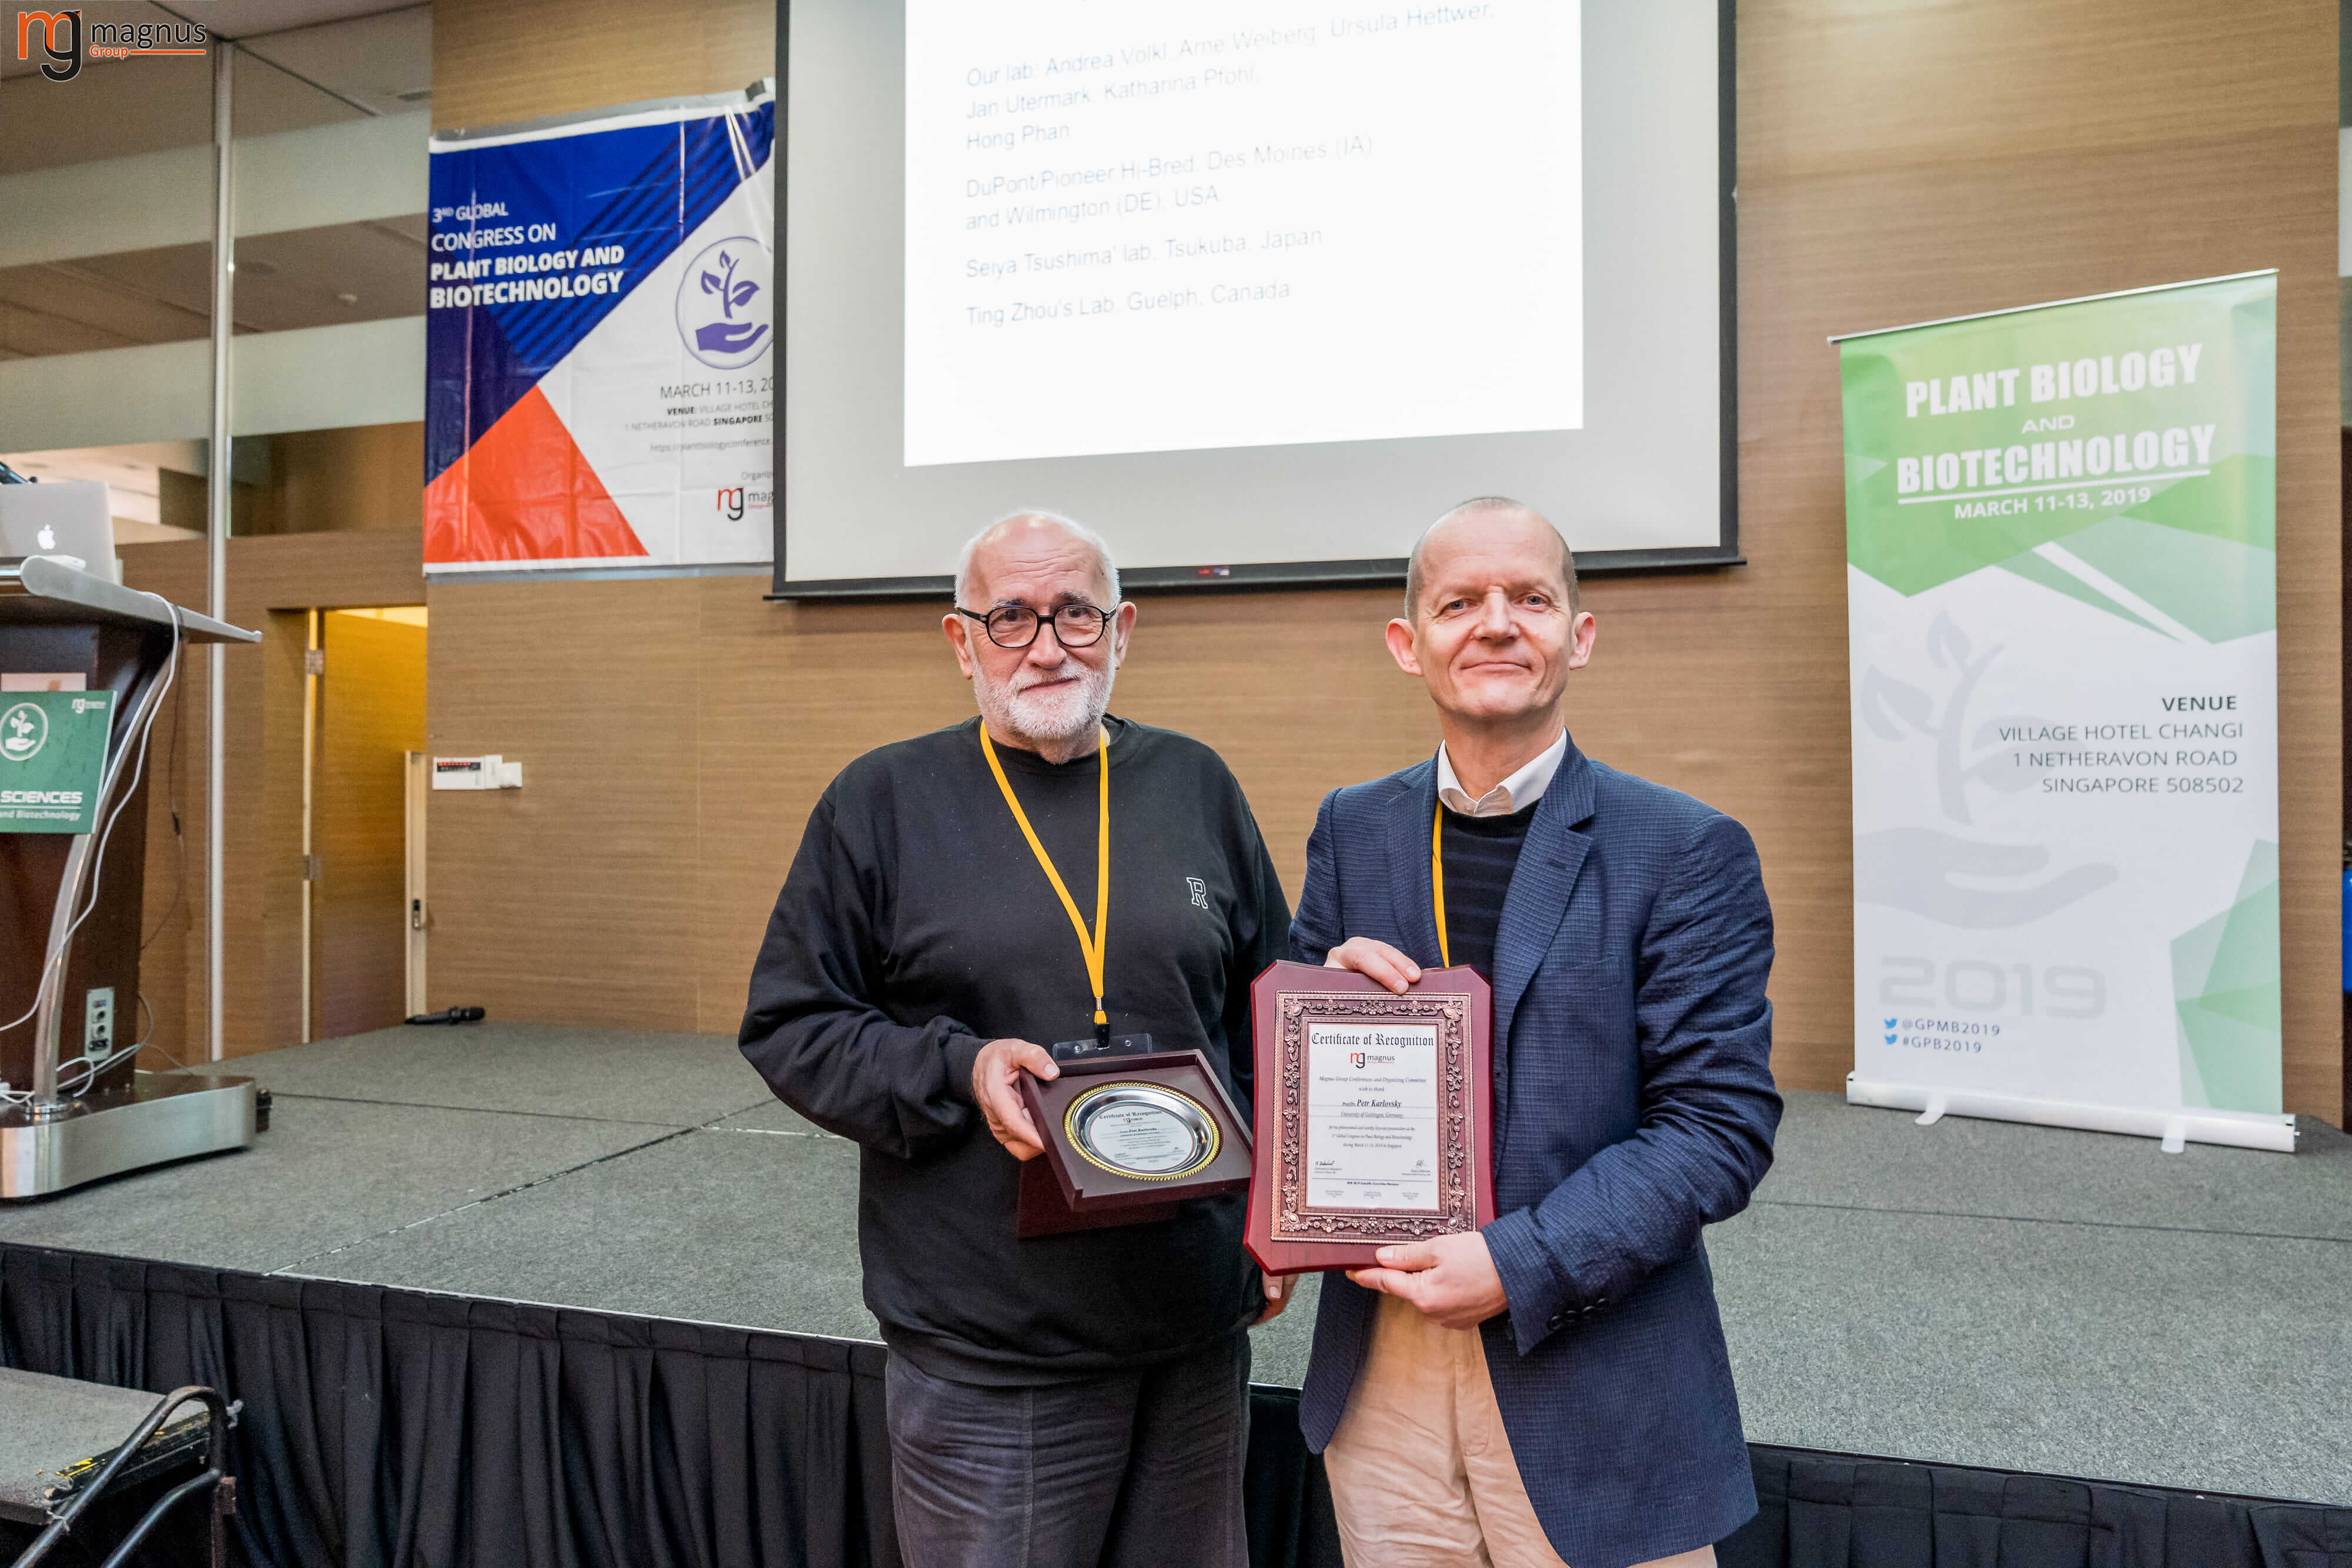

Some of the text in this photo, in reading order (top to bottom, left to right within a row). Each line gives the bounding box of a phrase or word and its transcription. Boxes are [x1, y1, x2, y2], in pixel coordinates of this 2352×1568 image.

[966, 68, 1000, 87] Our
[1045, 52, 1114, 75] Andrea
[1179, 37, 1225, 56] Arne
[1331, 14, 1398, 38] Ursula
[965, 101, 998, 120] Jan
[1105, 74, 1197, 100] Katharina
[966, 123, 1070, 151] Hong Phan
[1208, 149, 1247, 170] Des
[1254, 142, 1328, 165] Moines
[1336, 135, 1374, 161] (IA)
[455, 202, 509, 220] GLOBAL
[965, 210, 1000, 230] and
[1006, 200, 1111, 226] Wilmington
[1175, 185, 1220, 207] USA
[432, 223, 556, 252] CONGRESS ON
[430, 245, 625, 281] PLANT BIOLOGY AND
[966, 259, 1017, 282] Seiya
[1261, 229, 1322, 252] Japan
[430, 270, 624, 309] BIOTECHNOLOGY
[965, 305, 1004, 328] Ting
[1011, 297, 1073, 322] Zhou's
[1212, 279, 1291, 304] Canada
[660, 383, 711, 400] MARCH
[717, 379, 757, 395] 11-13,
[1906, 343, 2203, 418] PLANT BIOLOGY
[699, 404, 732, 414] VILLAGE
[735, 402, 760, 411] HOTEL
[689, 418, 710, 428] ROAD
[713, 414, 763, 426] SINGAPORE
[2022, 414, 2075, 434] AND
[1897, 424, 2216, 494] BIOTECHNOLOGY
[1954, 487, 2151, 519] MARCH 11-13, 2019
[2162, 695, 2237, 711] VENUE
[1999, 723, 2244, 742] VILLAGE HOTEL CHANGI
[2013, 750, 2238, 767] 1 NETHERAVON ROAD
[0, 790, 83, 804] SCIENCES
[2042, 777, 2244, 794] SINGAPORE 508502
[16, 810, 81, 822] Biotechnology
[1186, 877, 1209, 910] R
[1879, 955, 2107, 1020] 2019
[1902, 1018, 2000, 1037] @GPMB2019
[1312, 1032, 1434, 1048] Certificate of Recognition
[1902, 1035, 1982, 1054] #GPB2019
[1356, 1099, 1370, 1107] Petr
[1371, 1099, 1402, 1109] Karlovsky
